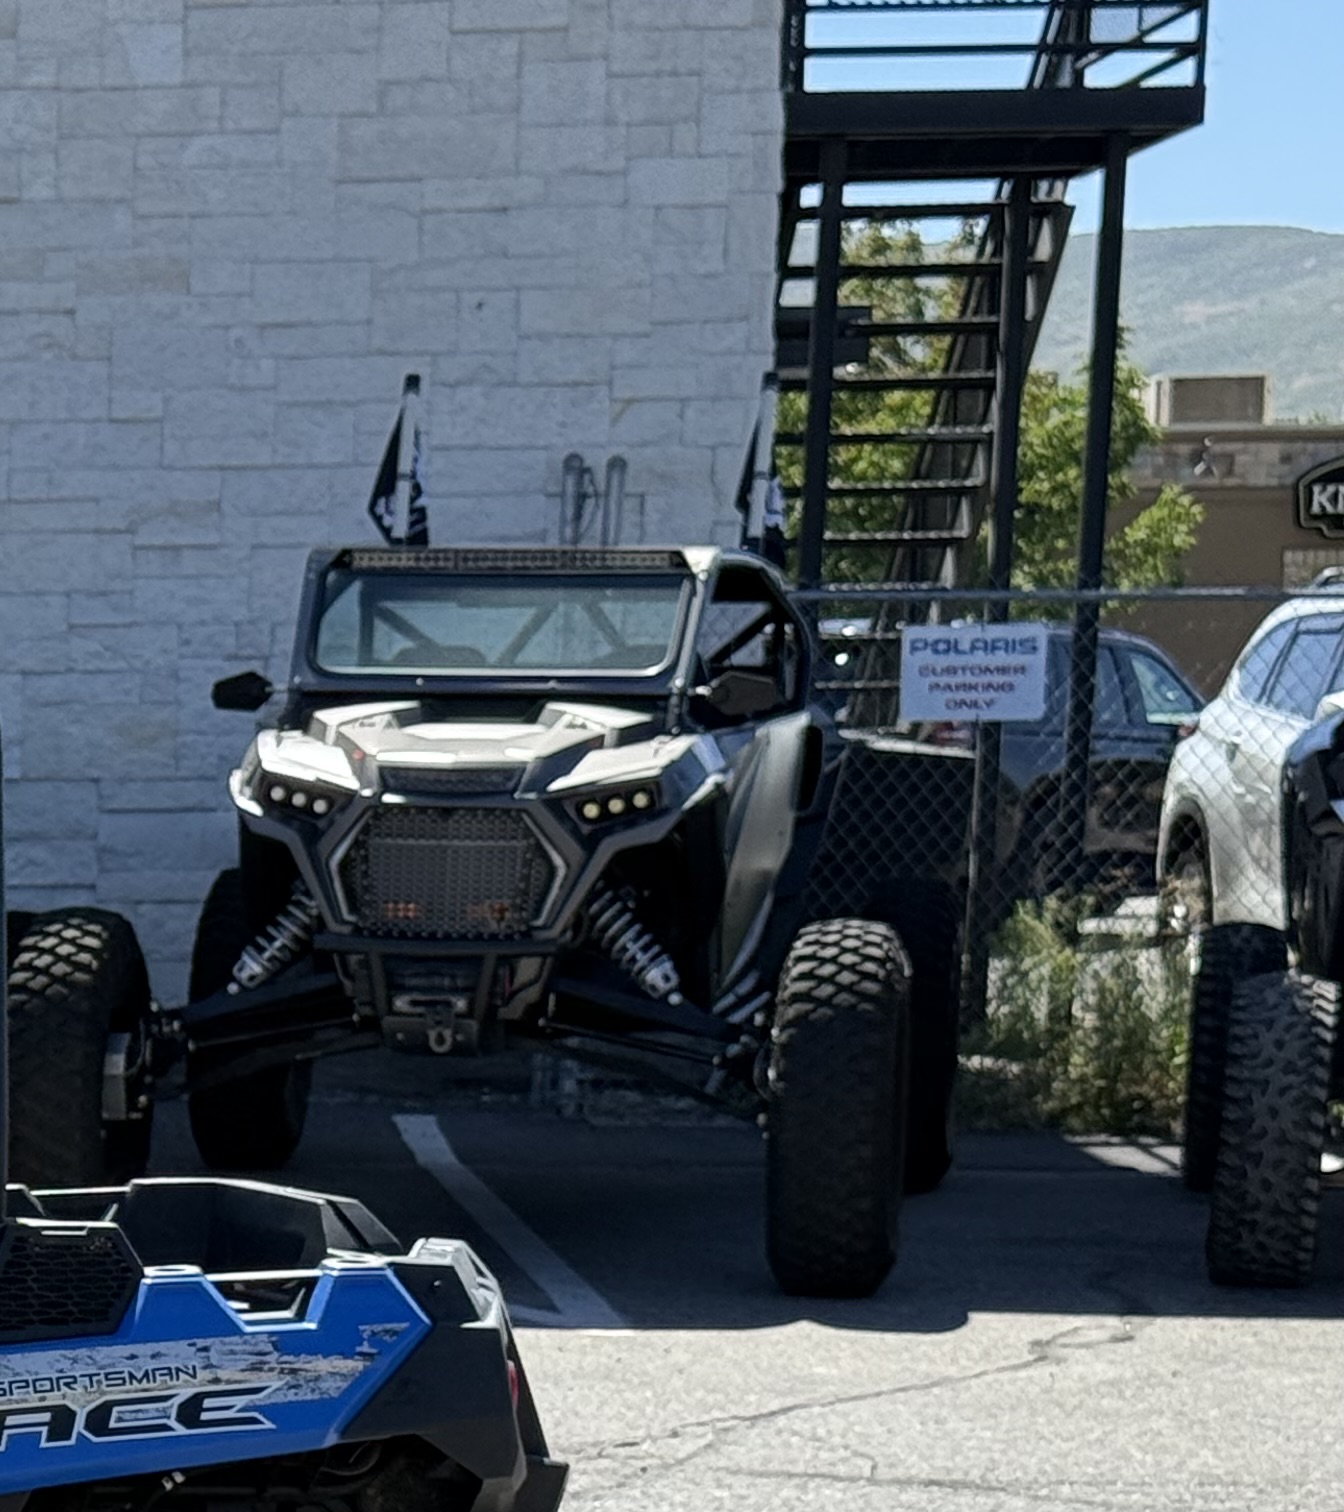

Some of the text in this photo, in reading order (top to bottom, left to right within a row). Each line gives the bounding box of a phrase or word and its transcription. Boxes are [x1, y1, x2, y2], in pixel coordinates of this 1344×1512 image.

[909, 636, 1038, 656] POLARIS
[918, 664, 1026, 678] CUSTOMER
[928, 681, 1016, 694] PARKING
[944, 698, 995, 711] ONLY
